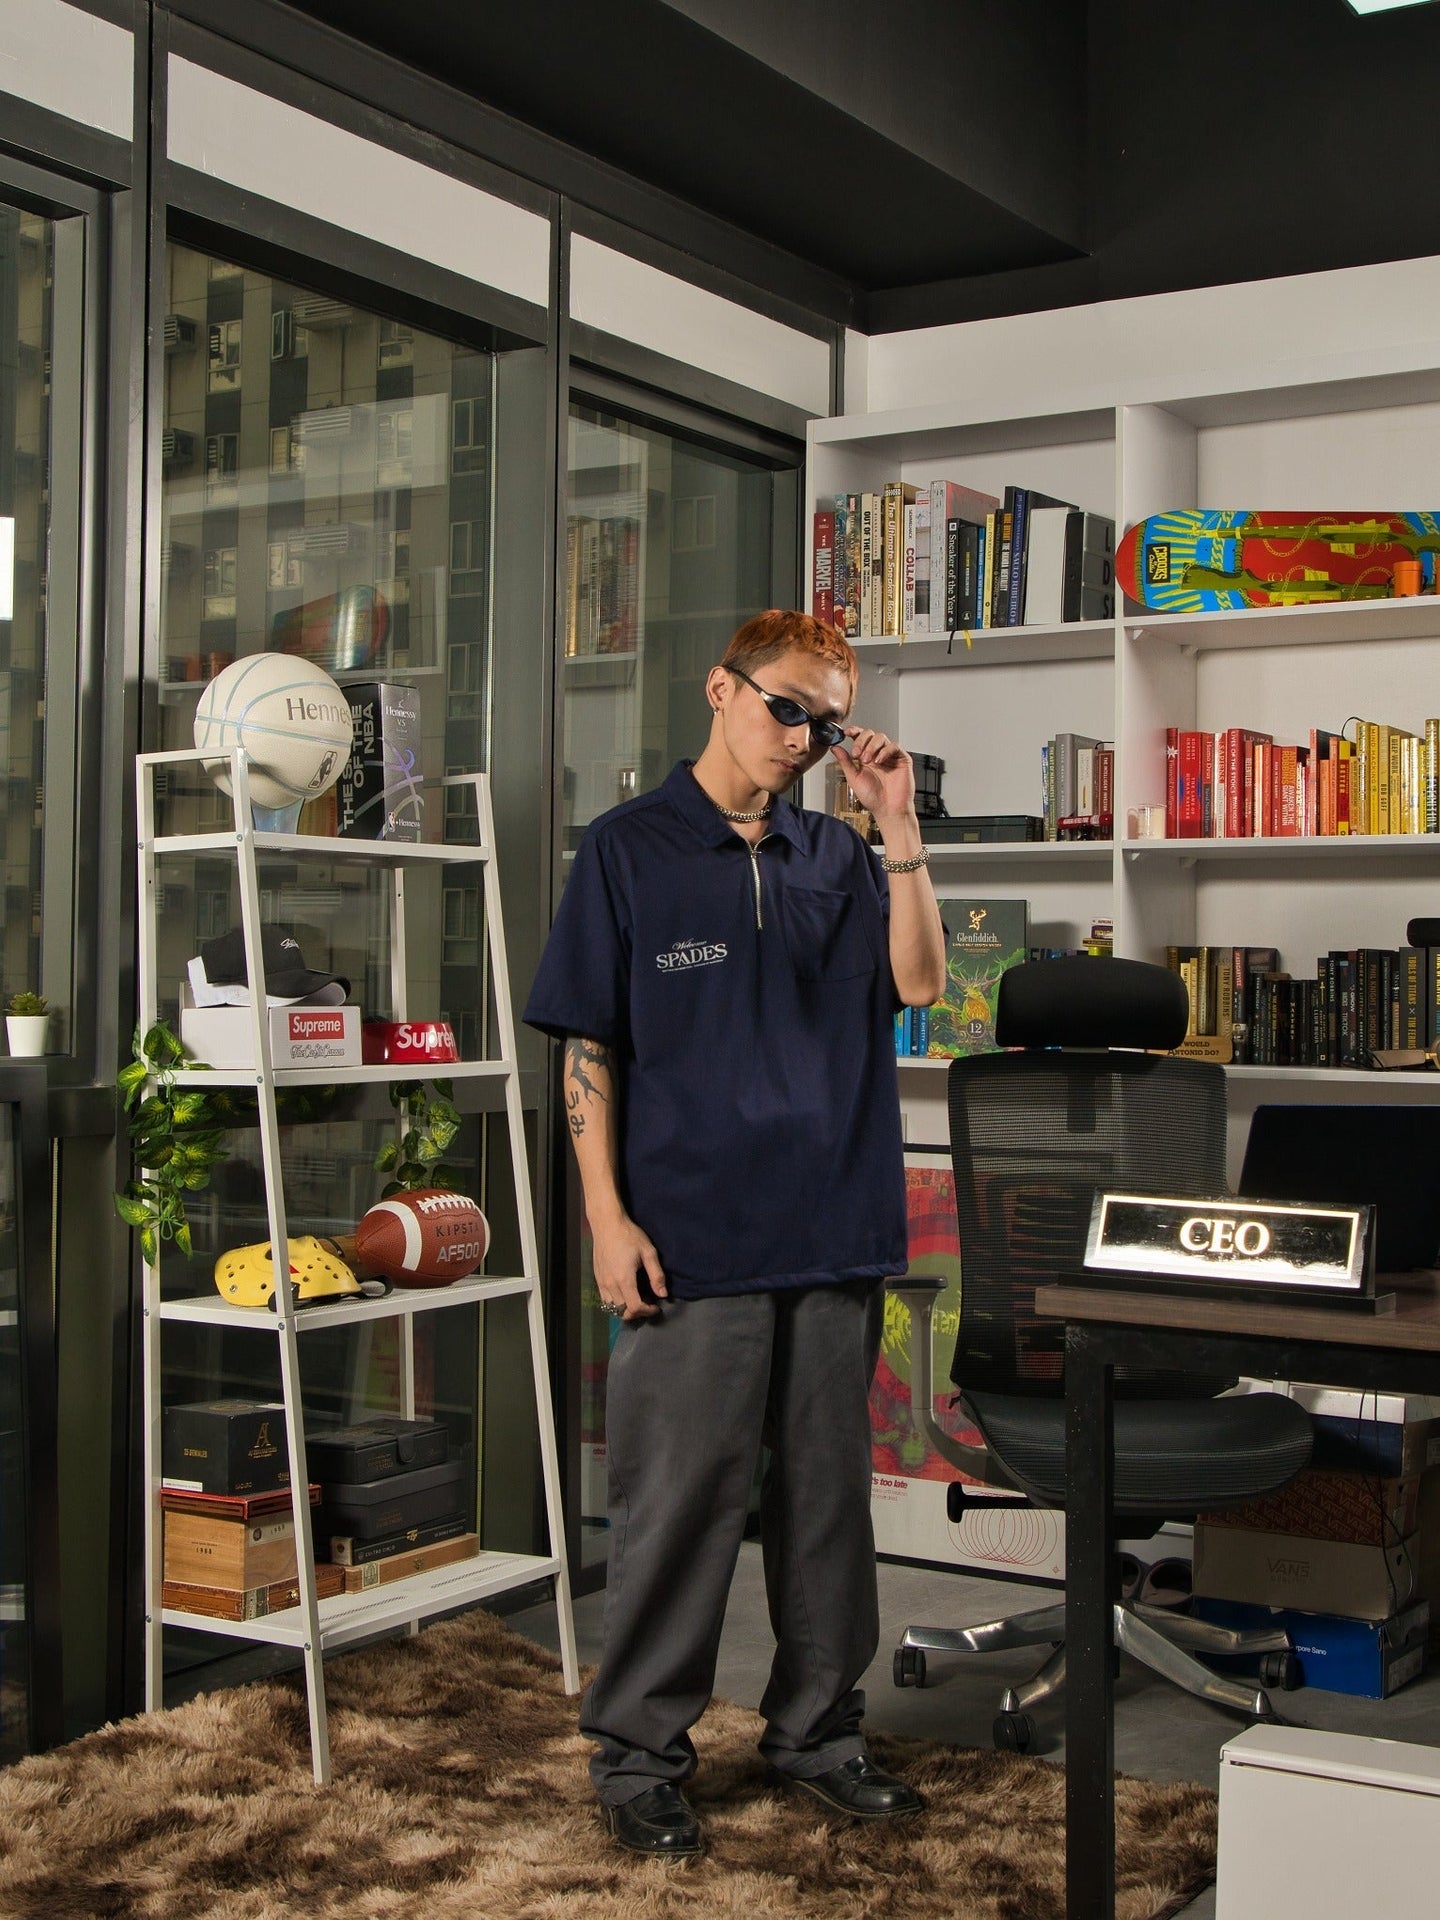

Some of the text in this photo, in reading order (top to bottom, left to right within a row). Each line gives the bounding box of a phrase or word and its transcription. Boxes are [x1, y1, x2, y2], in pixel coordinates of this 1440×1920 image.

[887, 502, 895, 518] The
[864, 527, 871, 536] OF
[887, 520, 896, 559] Ultimate
[948, 534, 956, 568] Sneaker
[815, 548, 831, 592] MARVEL
[905, 547, 914, 591] COLLAB
[948, 569, 956, 578] of
[1152, 546, 1167, 580] CROOKS
[887, 562, 896, 599] Sneaker
[947, 595, 955, 615] Year
[1010, 581, 1018, 617] RIBEIRO
[887, 600, 895, 623] Book
[386, 705, 416, 720] Hennessy
[363, 703, 374, 754] NBA
[352, 704, 364, 788] OF THE
[1230, 749, 1236, 757] OF
[343, 784, 354, 830] THE
[957, 932, 998, 942] Glenfiddich
[656, 944, 728, 968] SPADES
[1408, 956, 1416, 975] TOOLS
[1408, 984, 1416, 1005] TITANS
[293, 1016, 341, 1037] Supreme
[970, 1023, 982, 1034] 12
[1407, 1017, 1416, 1028] TIM
[1407, 1029, 1416, 1050] FERRIS
[436, 1222, 479, 1238] KIPSTA
[1179, 1216, 1271, 1256] CEO
[436, 1242, 480, 1264] AF500
[880, 1478, 908, 1489] too late
[1267, 1557, 1310, 1578] VANS
[1312, 1647, 1327, 1655] Sano
